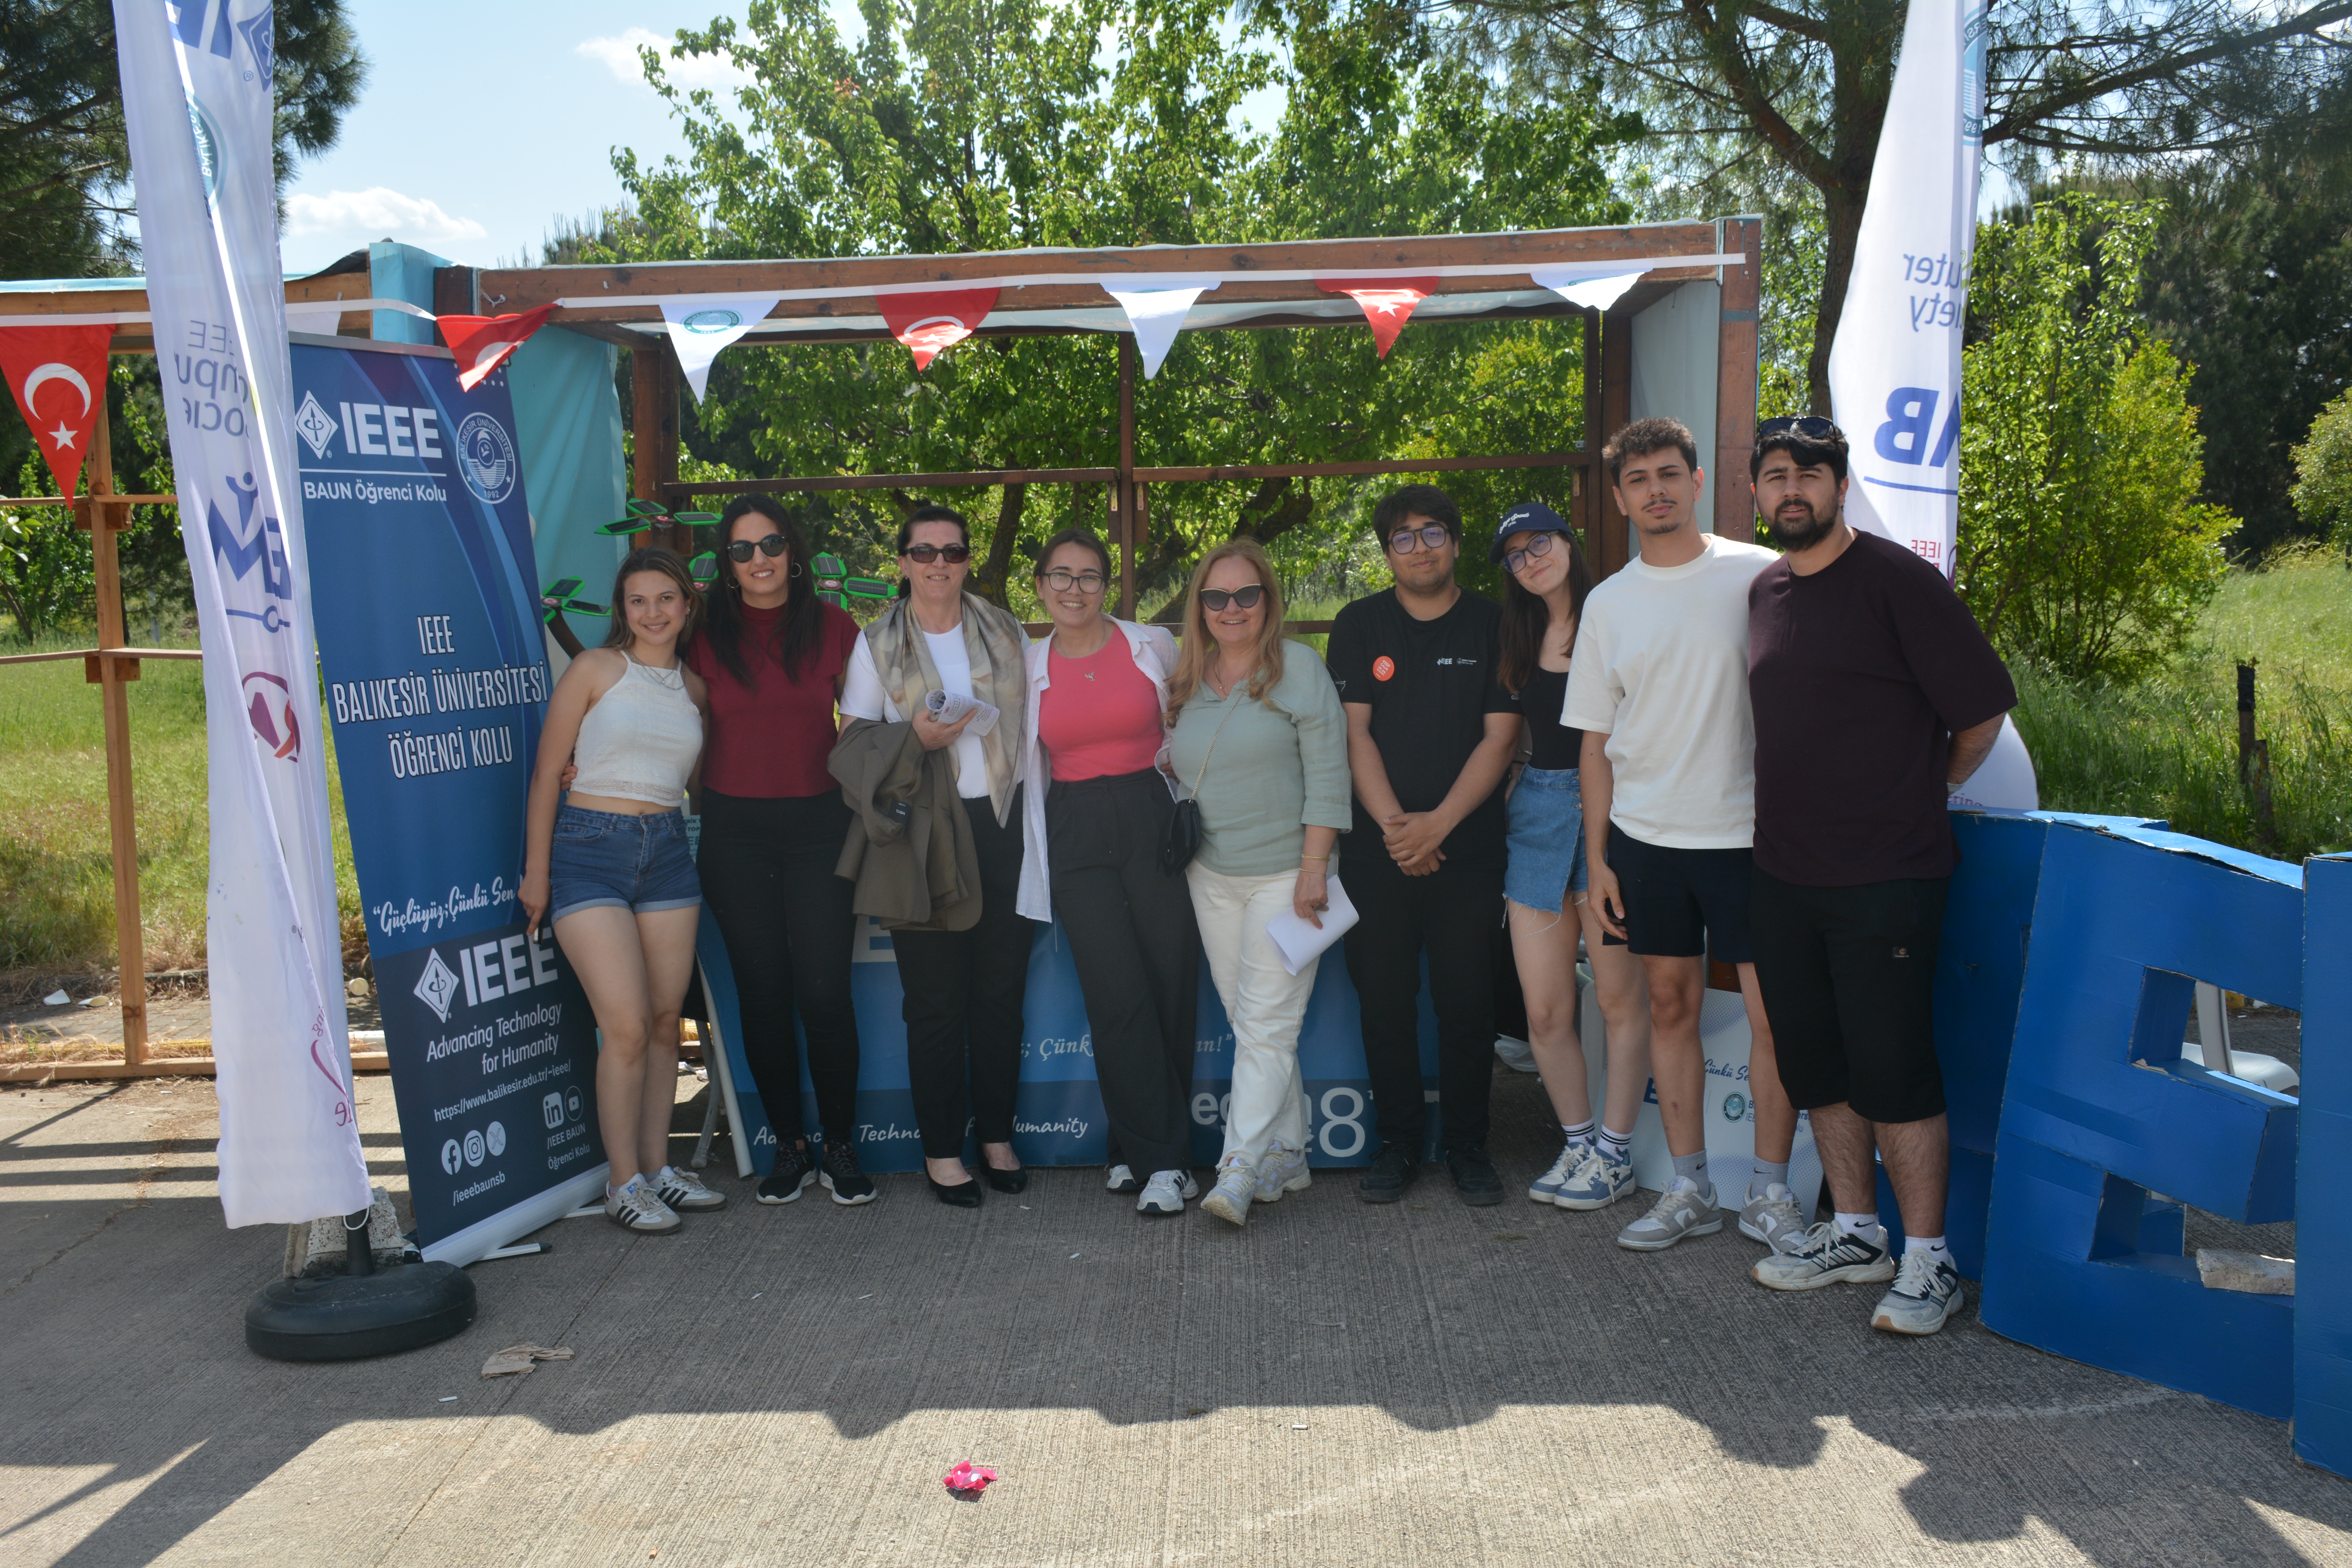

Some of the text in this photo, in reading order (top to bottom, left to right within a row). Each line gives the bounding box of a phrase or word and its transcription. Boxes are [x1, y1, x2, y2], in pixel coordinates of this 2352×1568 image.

[340, 401, 443, 459] IEEE
[460, 417, 513, 461] BALIKESİR ÜNİVERSİTESİ
[304, 479, 447, 504] BAUN Öğrenci Kolu
[417, 615, 455, 655] IEEE
[332, 660, 548, 724] BALIKESİR ÜNİVERSİTESİ
[387, 725, 513, 779] ÖĞRENCİ KOLU
[492, 876, 515, 906] Sen
[460, 926, 558, 1007] IEEE
[426, 1003, 562, 1062] Advancing Technology
[1040, 1034, 1094, 1061] Çünk
[482, 1033, 559, 1074] for Humanity
[1735, 1065, 1749, 1081] Se
[434, 1059, 571, 1122] https://www.balikesir.edu.tr/~ieee/
[547, 1123, 586, 1149] /IEEE BAUN
[859, 1123, 920, 1142] Techno
[548, 1143, 590, 1171] Öğrenci Kolu
[453, 1171, 506, 1206] /ieeebaunsb
